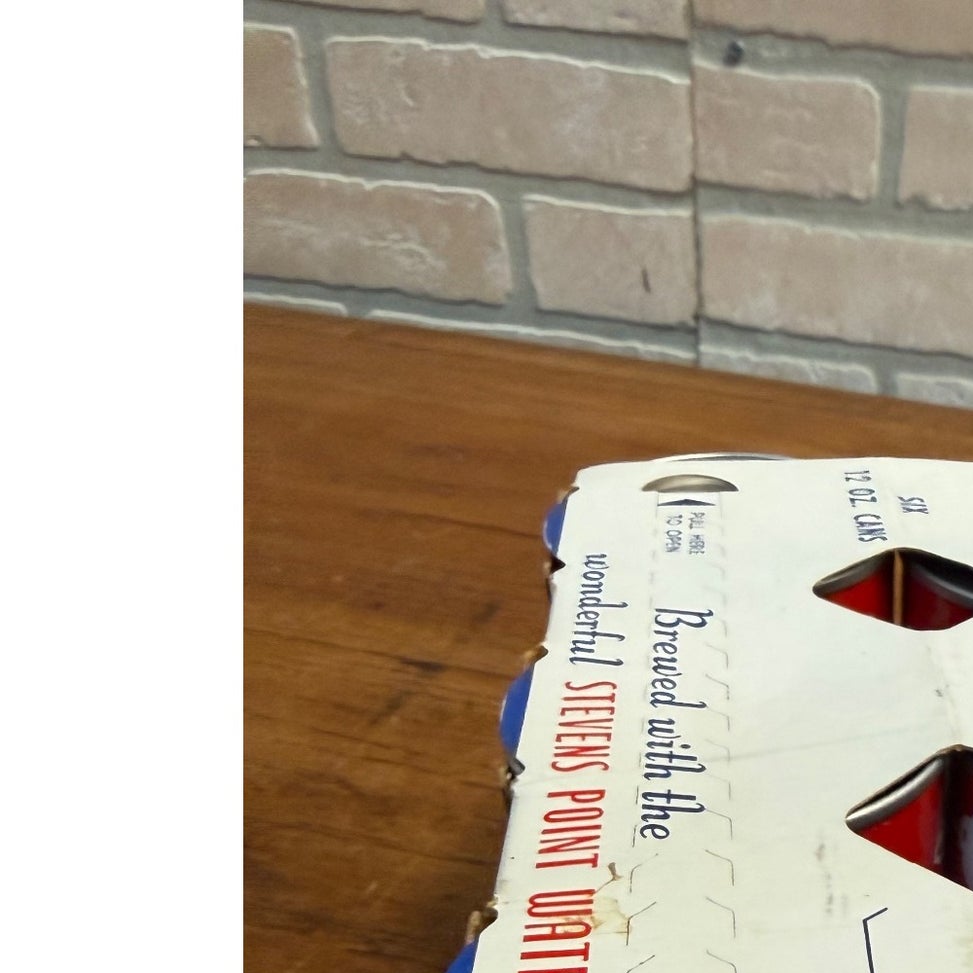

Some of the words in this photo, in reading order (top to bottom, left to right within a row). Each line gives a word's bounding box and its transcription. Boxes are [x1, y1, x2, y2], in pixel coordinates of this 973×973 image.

[844, 470, 872, 482] 12
[665, 514, 683, 526] TO
[853, 513, 888, 542] CANS
[897, 496, 929, 514] SIX
[665, 529, 683, 553] OPEN
[569, 553, 628, 667] wonderful
[650, 608, 714, 709] Brewed
[551, 681, 618, 772] STEVENS
[644, 718, 707, 781] with
[535, 789, 606, 869] POINT
[639, 789, 706, 840] the
